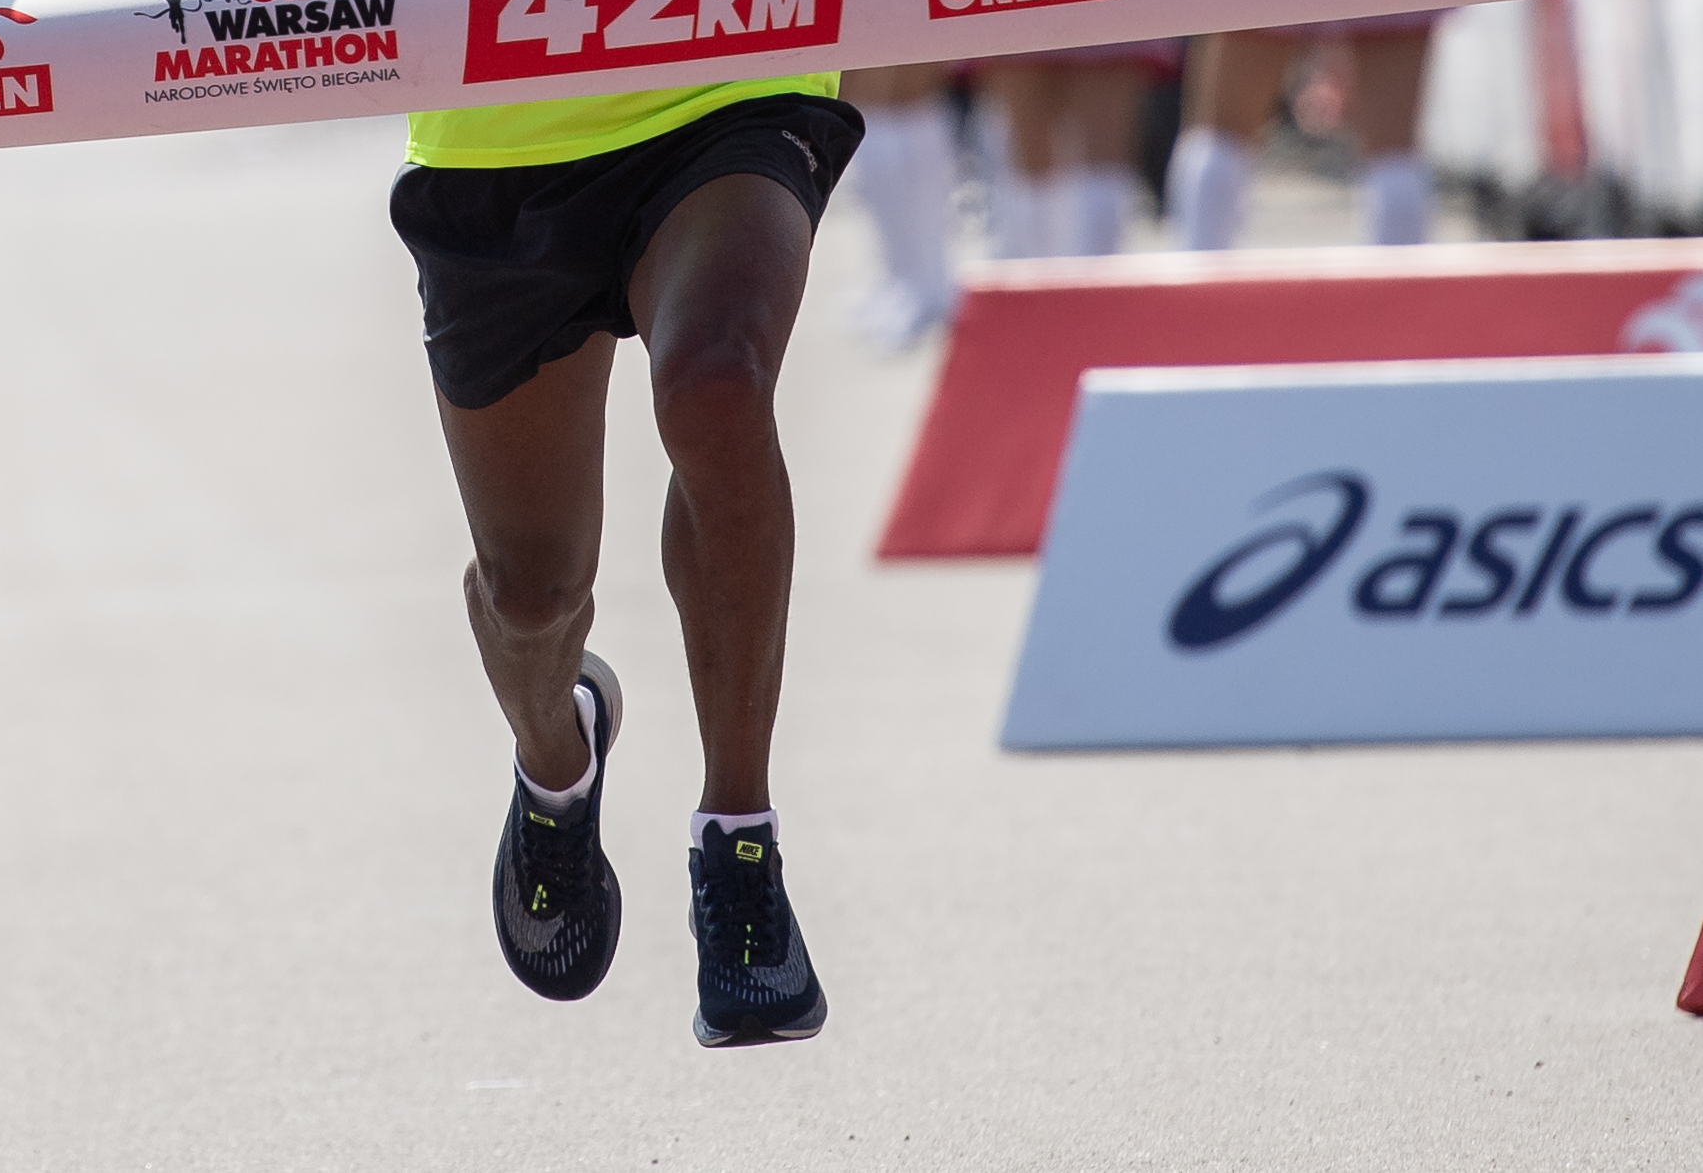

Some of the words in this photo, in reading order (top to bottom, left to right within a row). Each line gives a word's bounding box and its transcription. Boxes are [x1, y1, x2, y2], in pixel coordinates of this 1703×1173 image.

[155, 30, 399, 82] MARATHON
[145, 81, 248, 103] NARODOWE
[253, 75, 316, 94] ŚWIĘTO
[322, 68, 400, 88] BIEGANIA
